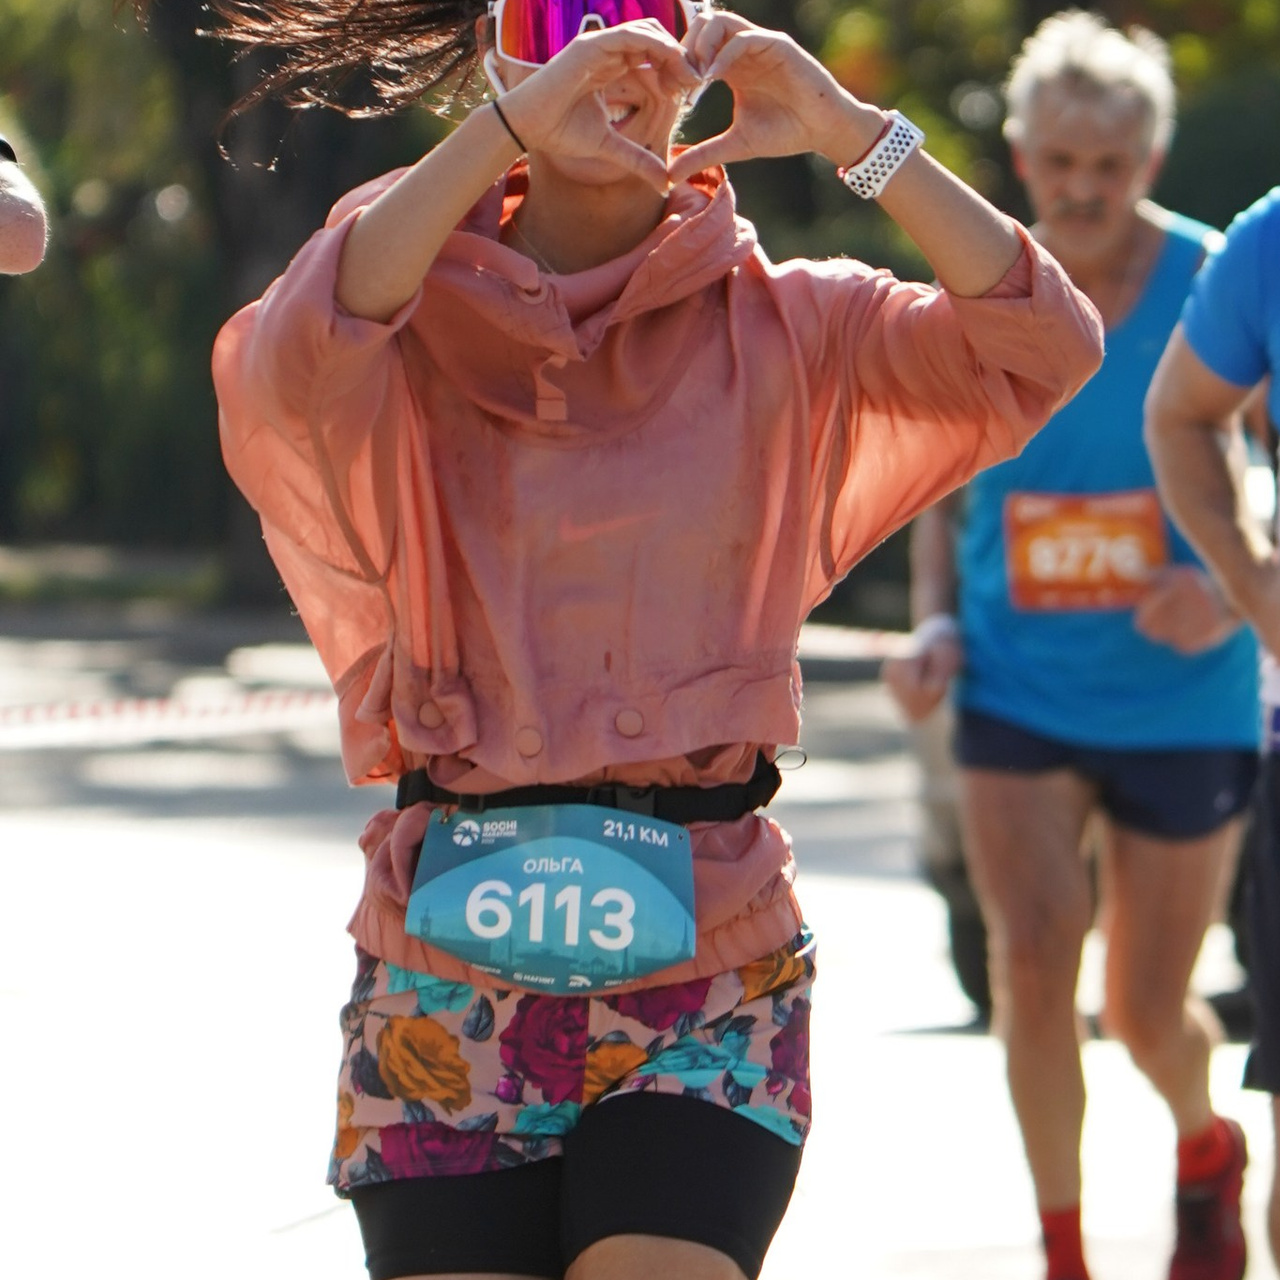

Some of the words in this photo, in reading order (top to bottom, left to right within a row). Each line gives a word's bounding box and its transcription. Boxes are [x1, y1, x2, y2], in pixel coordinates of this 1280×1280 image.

[483, 821, 517, 831] SOCHI
[603, 820, 635, 841] 21,1
[523, 857, 584, 875] ОЛЬГА
[465, 879, 636, 951] 6113
